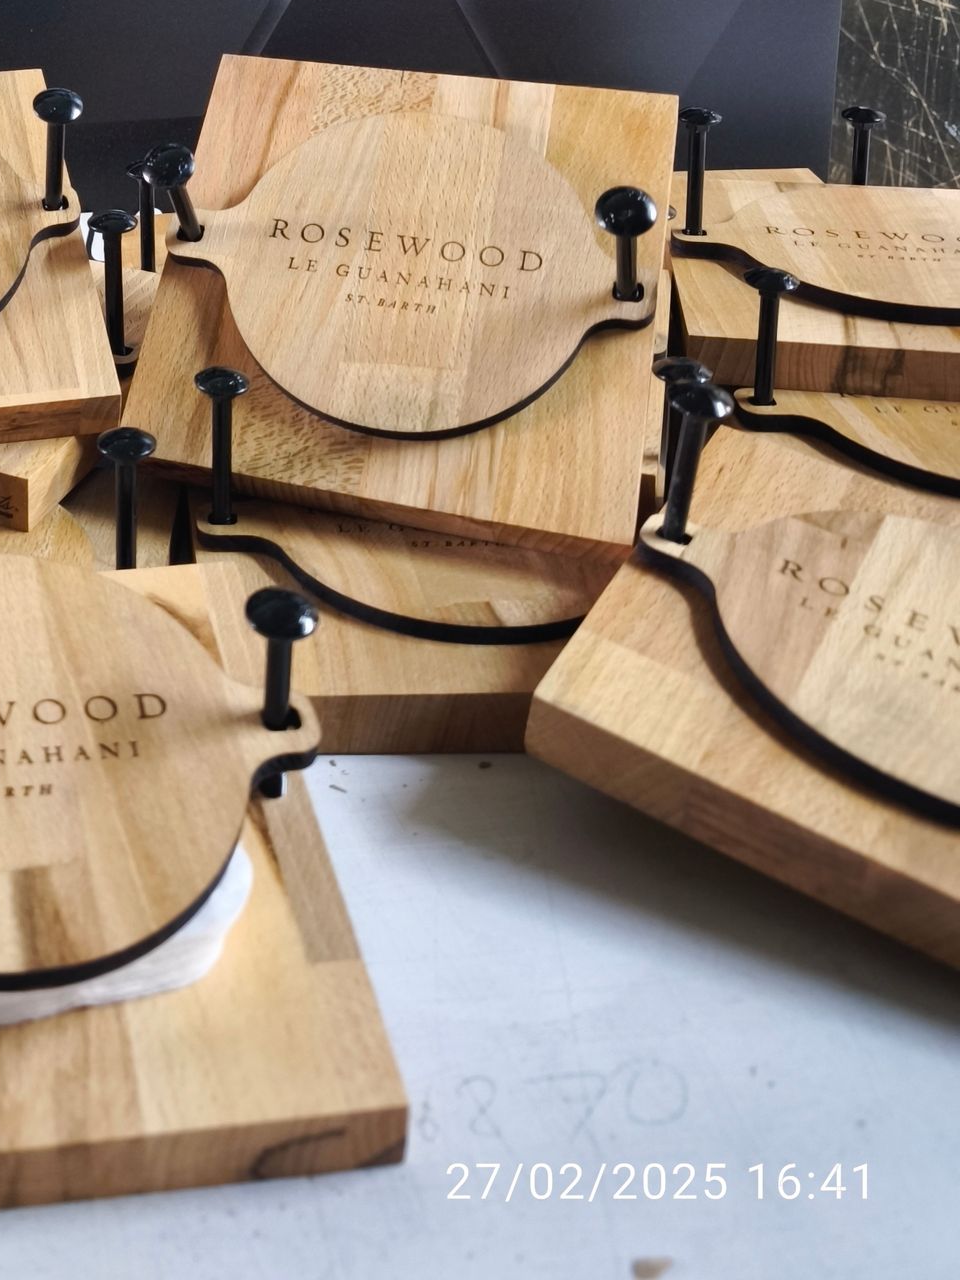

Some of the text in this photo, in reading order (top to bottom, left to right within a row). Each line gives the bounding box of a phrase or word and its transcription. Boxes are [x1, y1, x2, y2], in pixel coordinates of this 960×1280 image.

[269, 219, 543, 271] ROSEWOOD
[765, 226, 960, 243] ROSEWO
[289, 257, 510, 300] LE GUANAHANI
